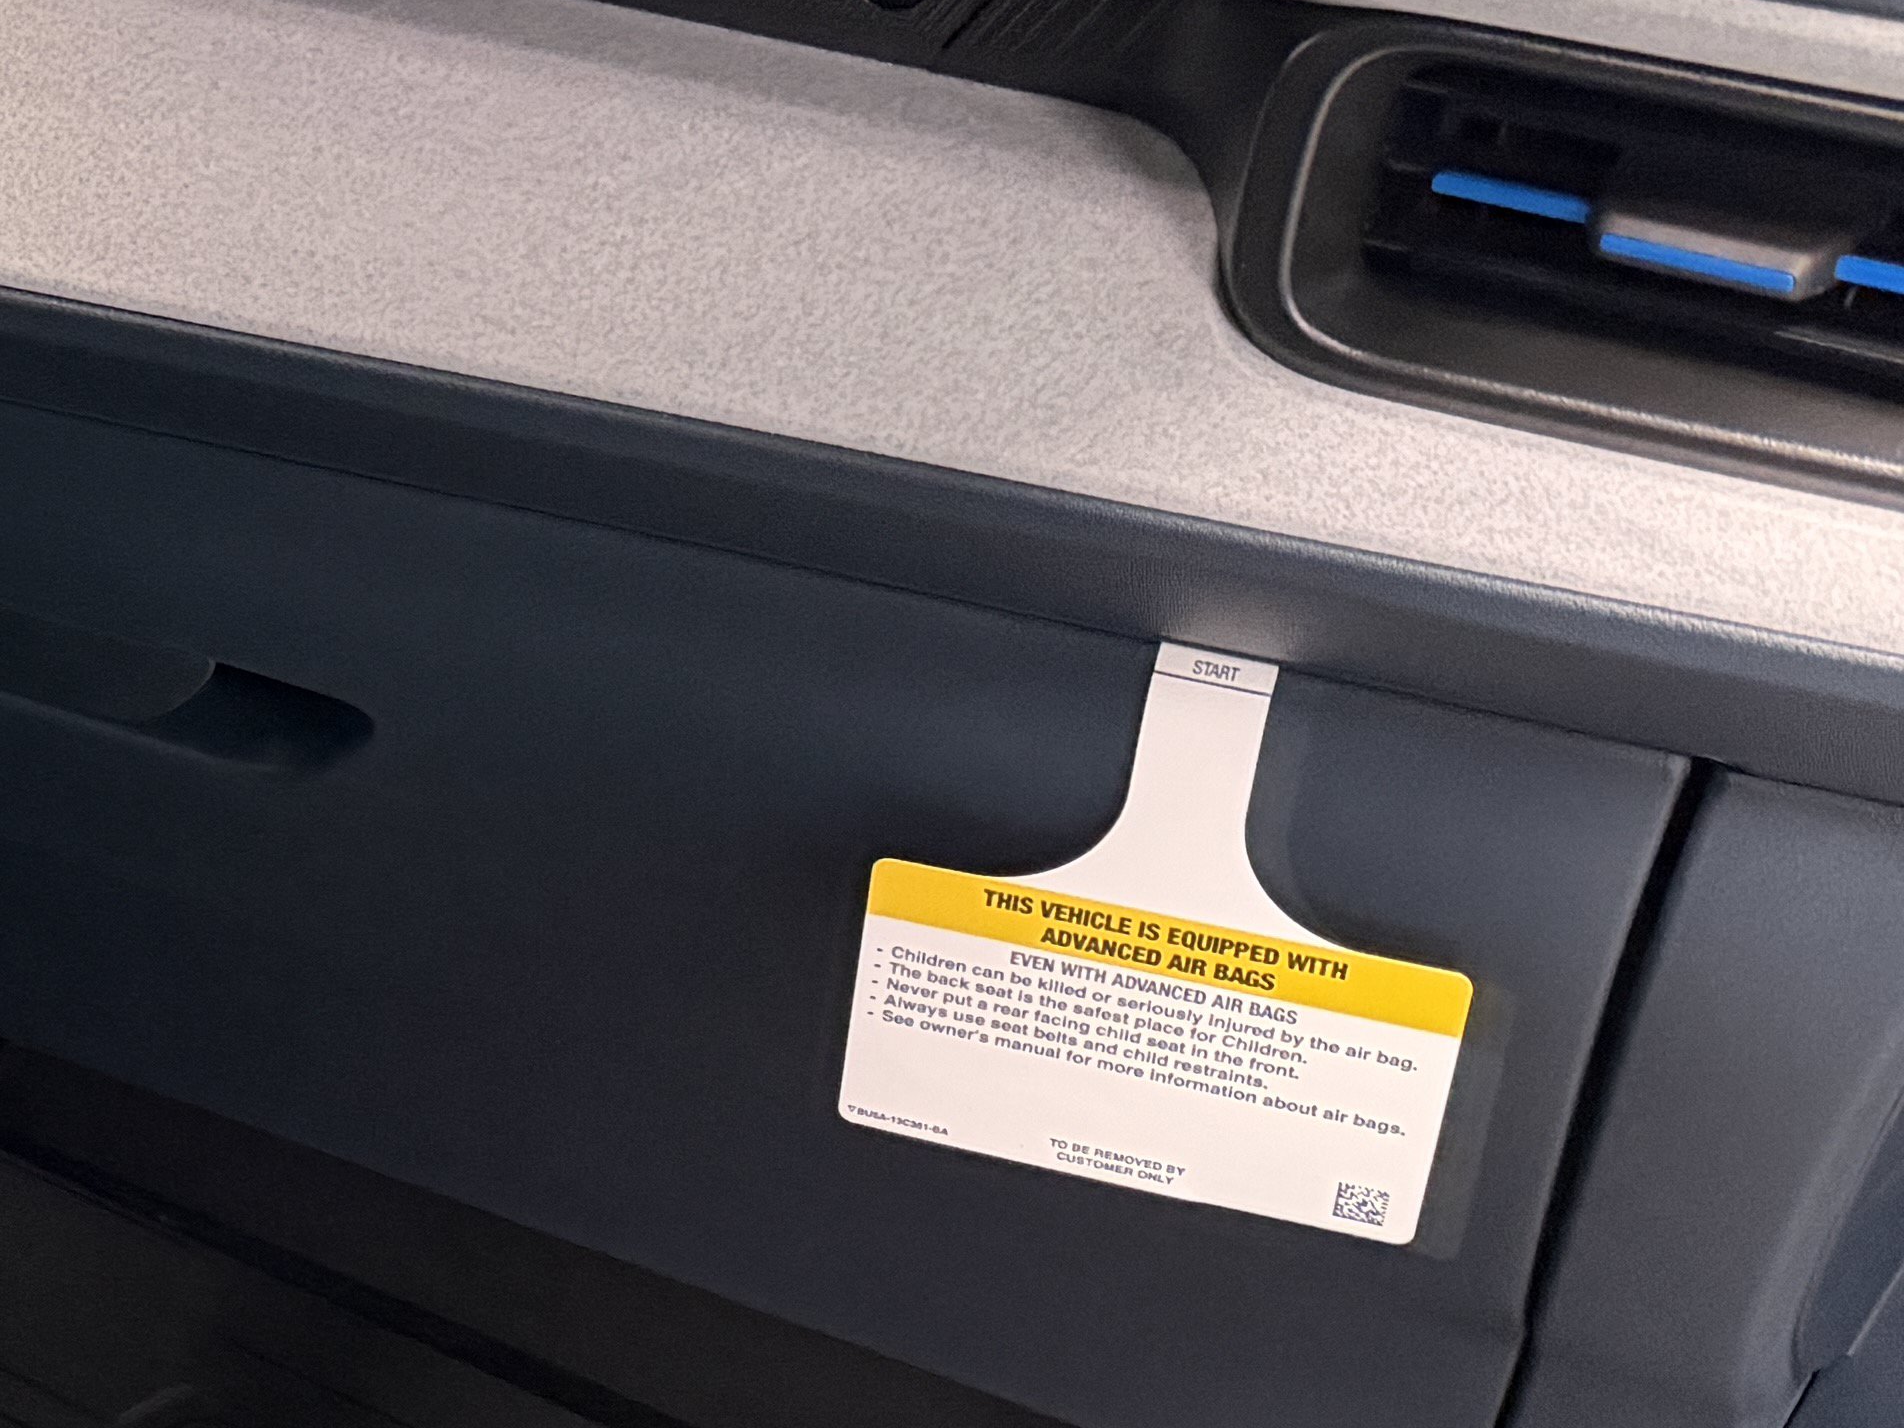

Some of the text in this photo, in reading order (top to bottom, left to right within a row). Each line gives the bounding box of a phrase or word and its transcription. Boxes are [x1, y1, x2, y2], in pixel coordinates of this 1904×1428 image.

[1193, 659, 1241, 682] START
[984, 888, 1349, 981] THIS VEHICLE IS EQUIPPED WITH
[1040, 927, 1276, 992] ADVANCED AIR BAGS
[886, 976, 1300, 1080] Never put a rear facing child seat in the front.
[889, 961, 1308, 1065] The back seat is the safest place for Children.
[891, 945, 1418, 1073] Children can be killed or seriously injured by the air bag.
[1010, 951, 1298, 1025] EVEN WITH ADVANCED AIR BAGS
[882, 1009, 1406, 1137] See owner's manual for more information about air bags.
[883, 993, 1268, 1090] Always use seat belts and child restraints.
[1049, 1138, 1187, 1177] TO BE REMOVED BY
[1056, 1151, 1175, 1186] CUSTOMER ONLY
